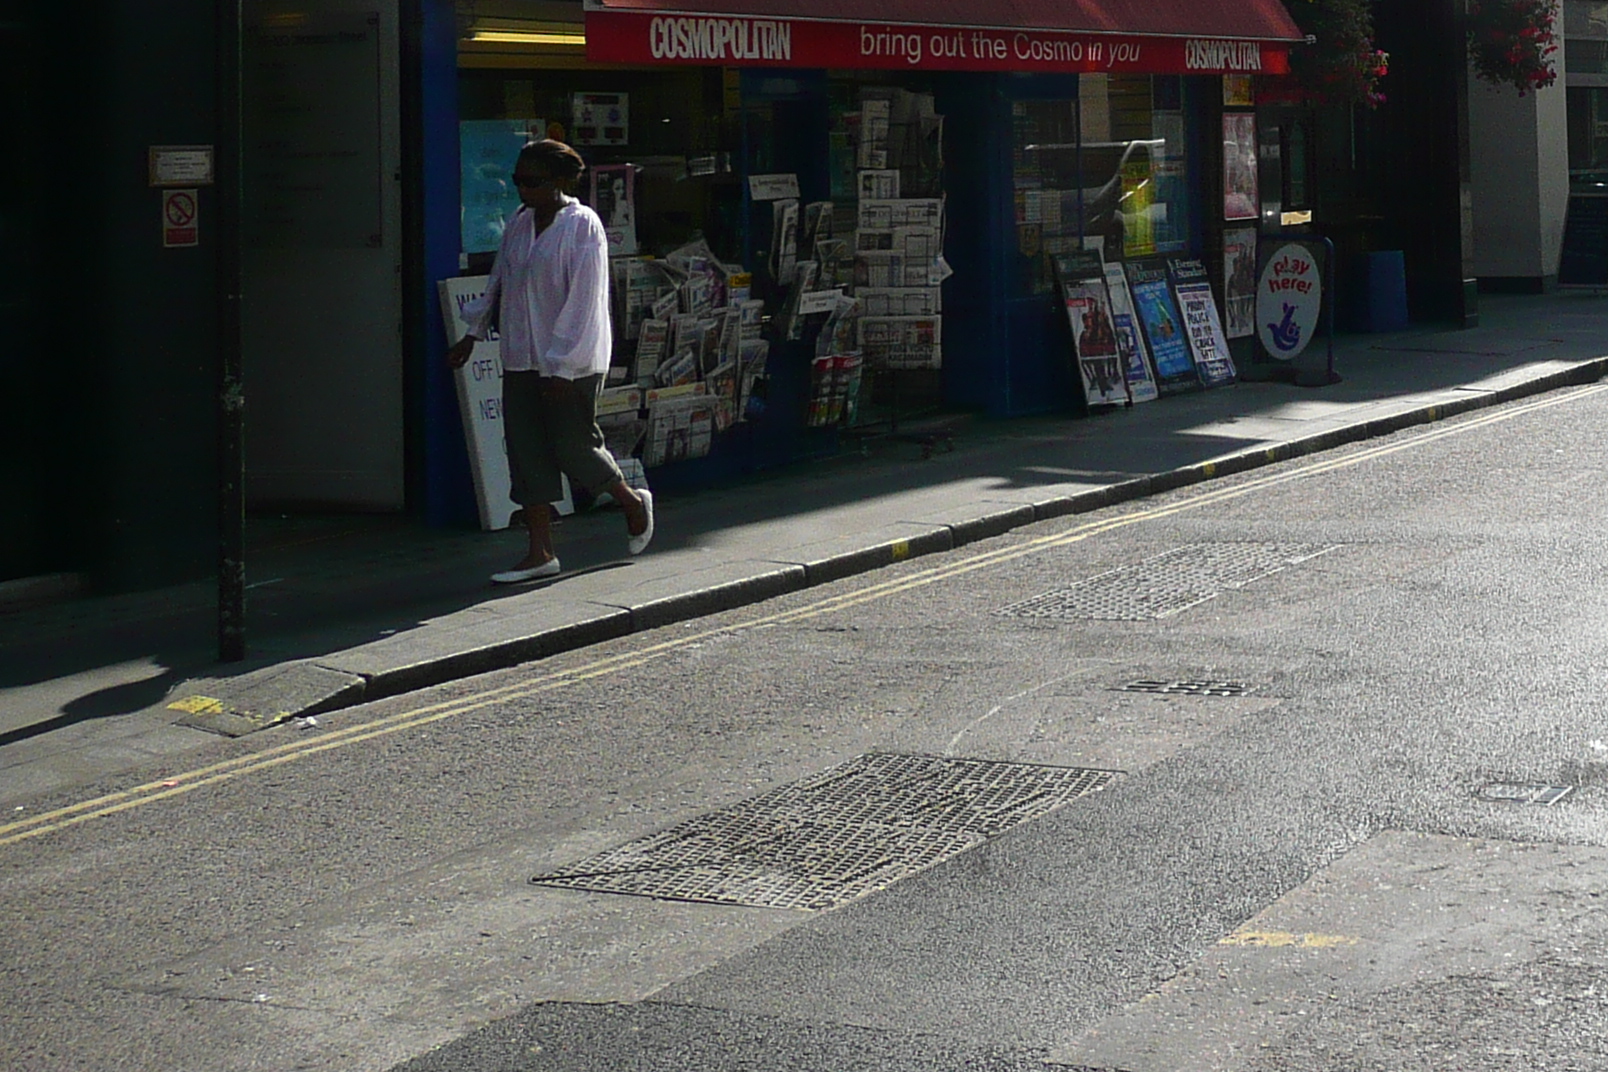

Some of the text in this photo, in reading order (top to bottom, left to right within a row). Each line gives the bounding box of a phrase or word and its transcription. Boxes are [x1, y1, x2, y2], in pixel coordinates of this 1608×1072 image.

[649, 17, 792, 62] COSMOPOLITAN
[860, 25, 1141, 67] bring out the Cosmo in you
[1184, 39, 1262, 71] COSMOPOLITAN
[1273, 256, 1311, 276] play
[1267, 278, 1312, 294] here!
[472, 359, 493, 382] OFF
[479, 397, 501, 420] NE
